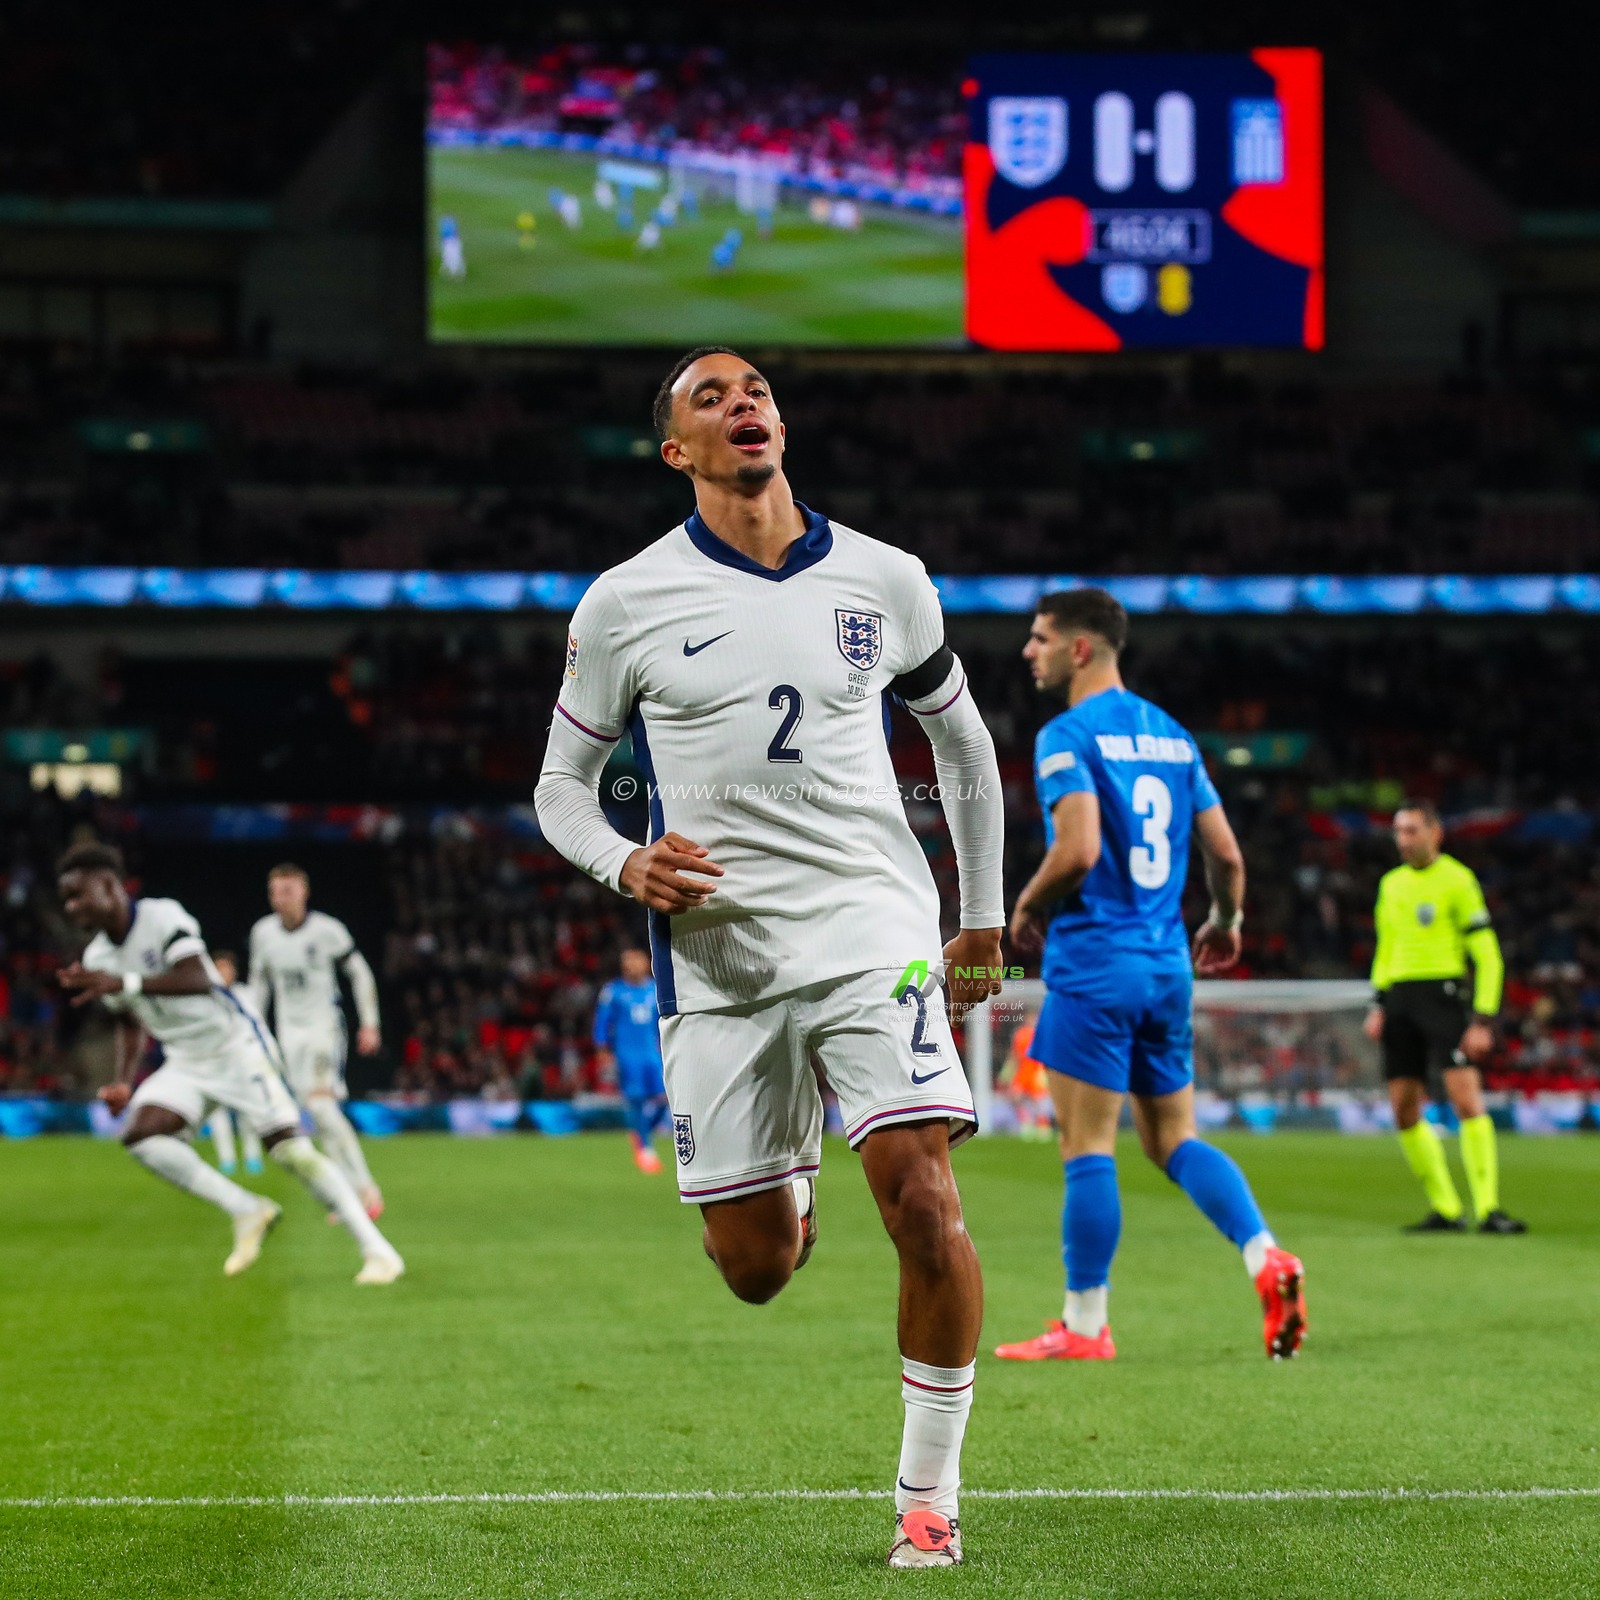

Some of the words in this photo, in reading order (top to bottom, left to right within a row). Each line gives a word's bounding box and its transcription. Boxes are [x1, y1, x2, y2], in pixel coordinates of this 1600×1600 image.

[849, 673, 869, 686] GREECE
[767, 684, 804, 763] 2
[1129, 774, 1173, 890] 3
[897, 985, 942, 1057] 2
